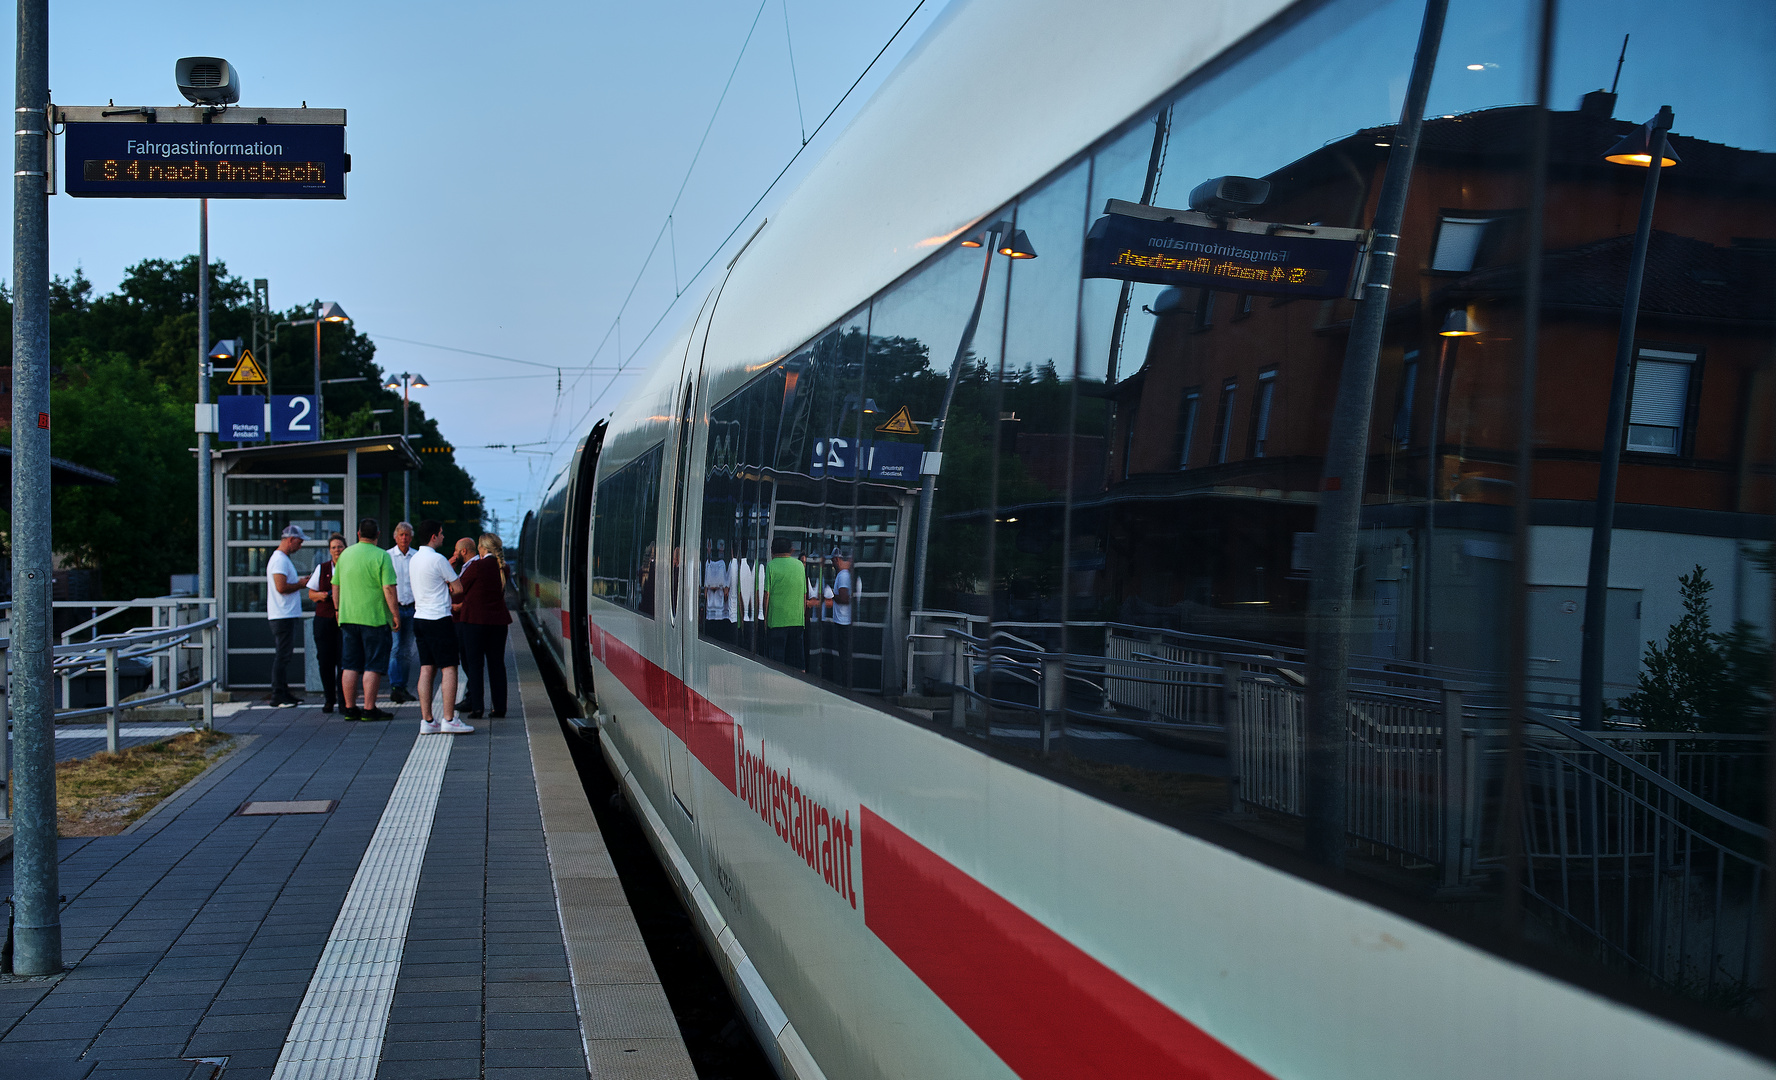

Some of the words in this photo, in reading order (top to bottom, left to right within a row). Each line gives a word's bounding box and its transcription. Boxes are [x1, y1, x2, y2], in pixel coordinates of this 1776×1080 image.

[127, 140, 283, 157] Fahrgastinformation
[104, 160, 118, 180] S
[127, 160, 140, 179] 4
[149, 160, 208, 180] nach
[288, 396, 311, 431] 2
[737, 723, 857, 910] Bordrestaurant
